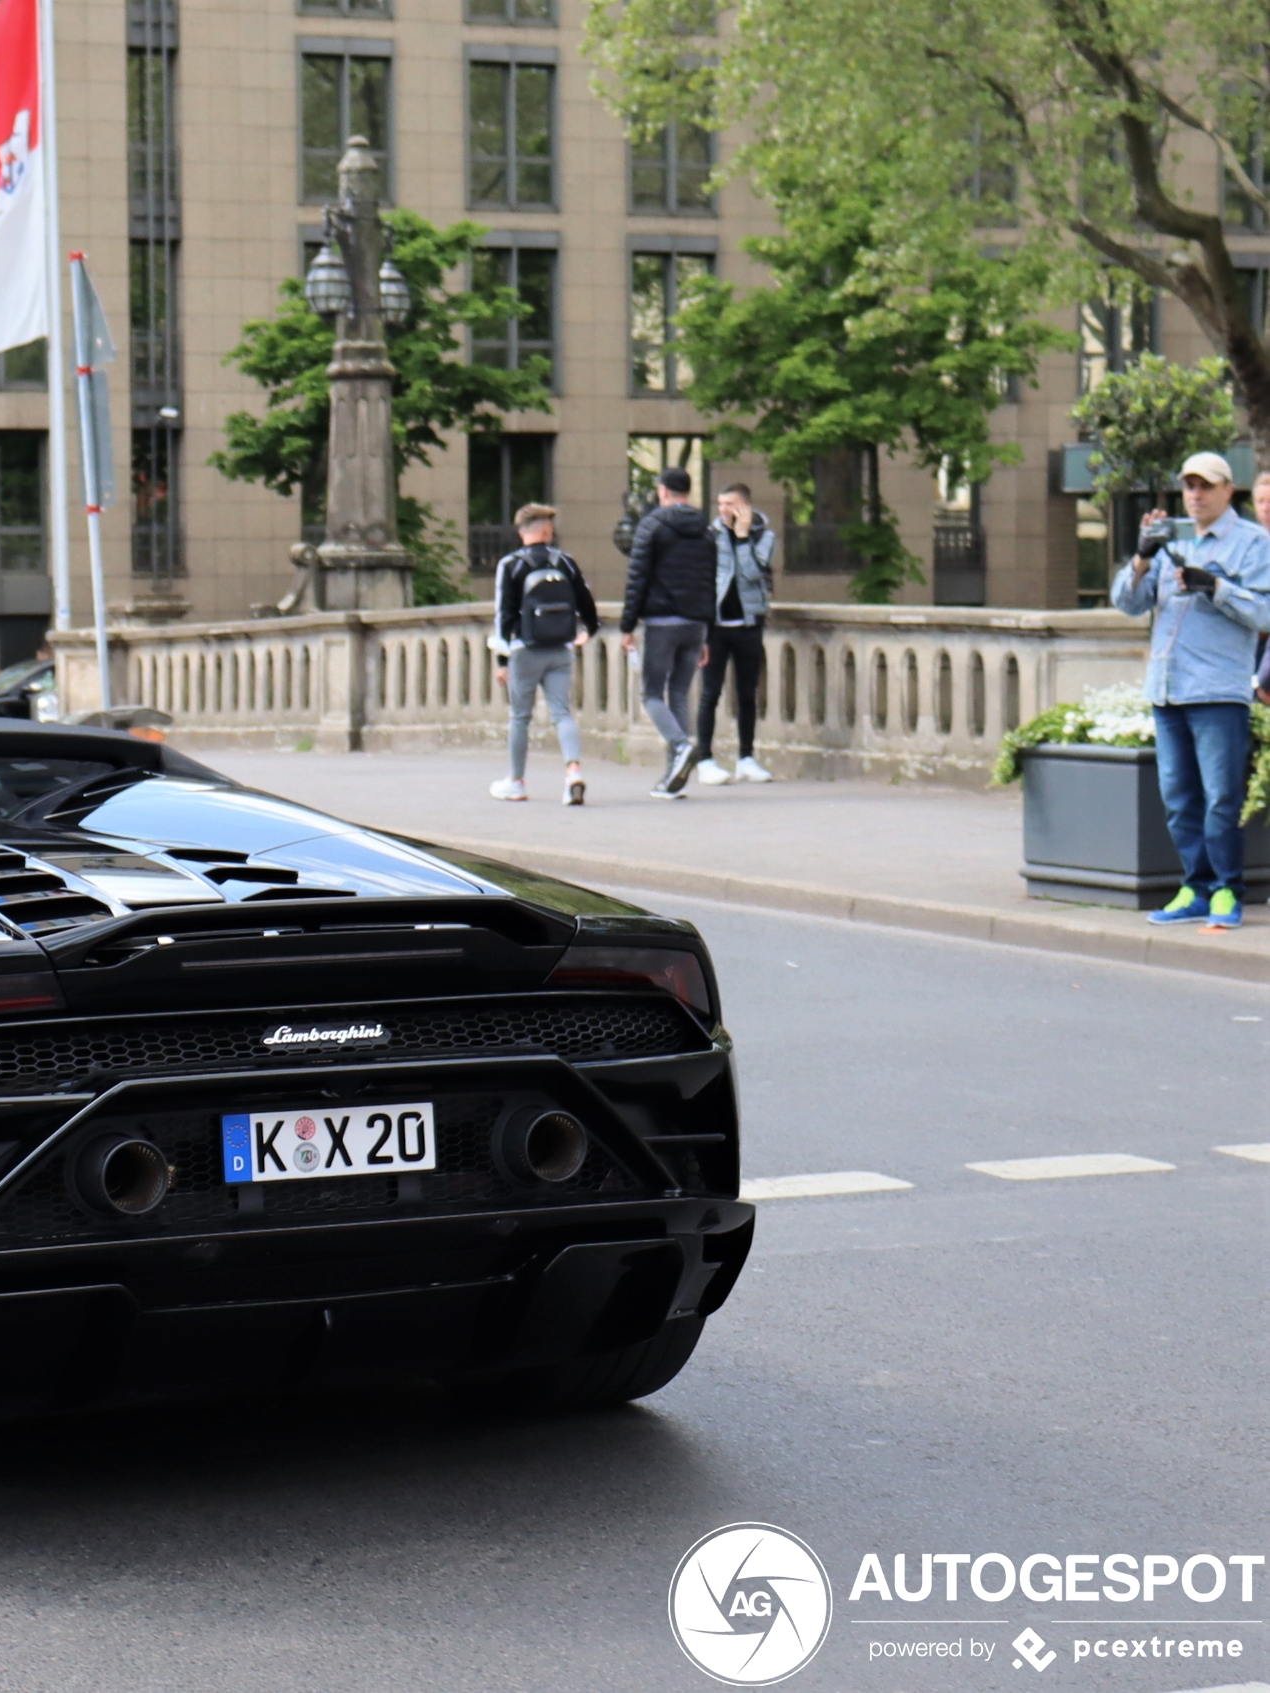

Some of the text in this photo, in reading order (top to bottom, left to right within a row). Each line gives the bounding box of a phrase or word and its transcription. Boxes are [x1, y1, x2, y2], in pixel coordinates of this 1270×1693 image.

[263, 1024, 383, 1045] Lamborghini
[255, 1120, 287, 1173] K
[232, 1155, 245, 1172] D
